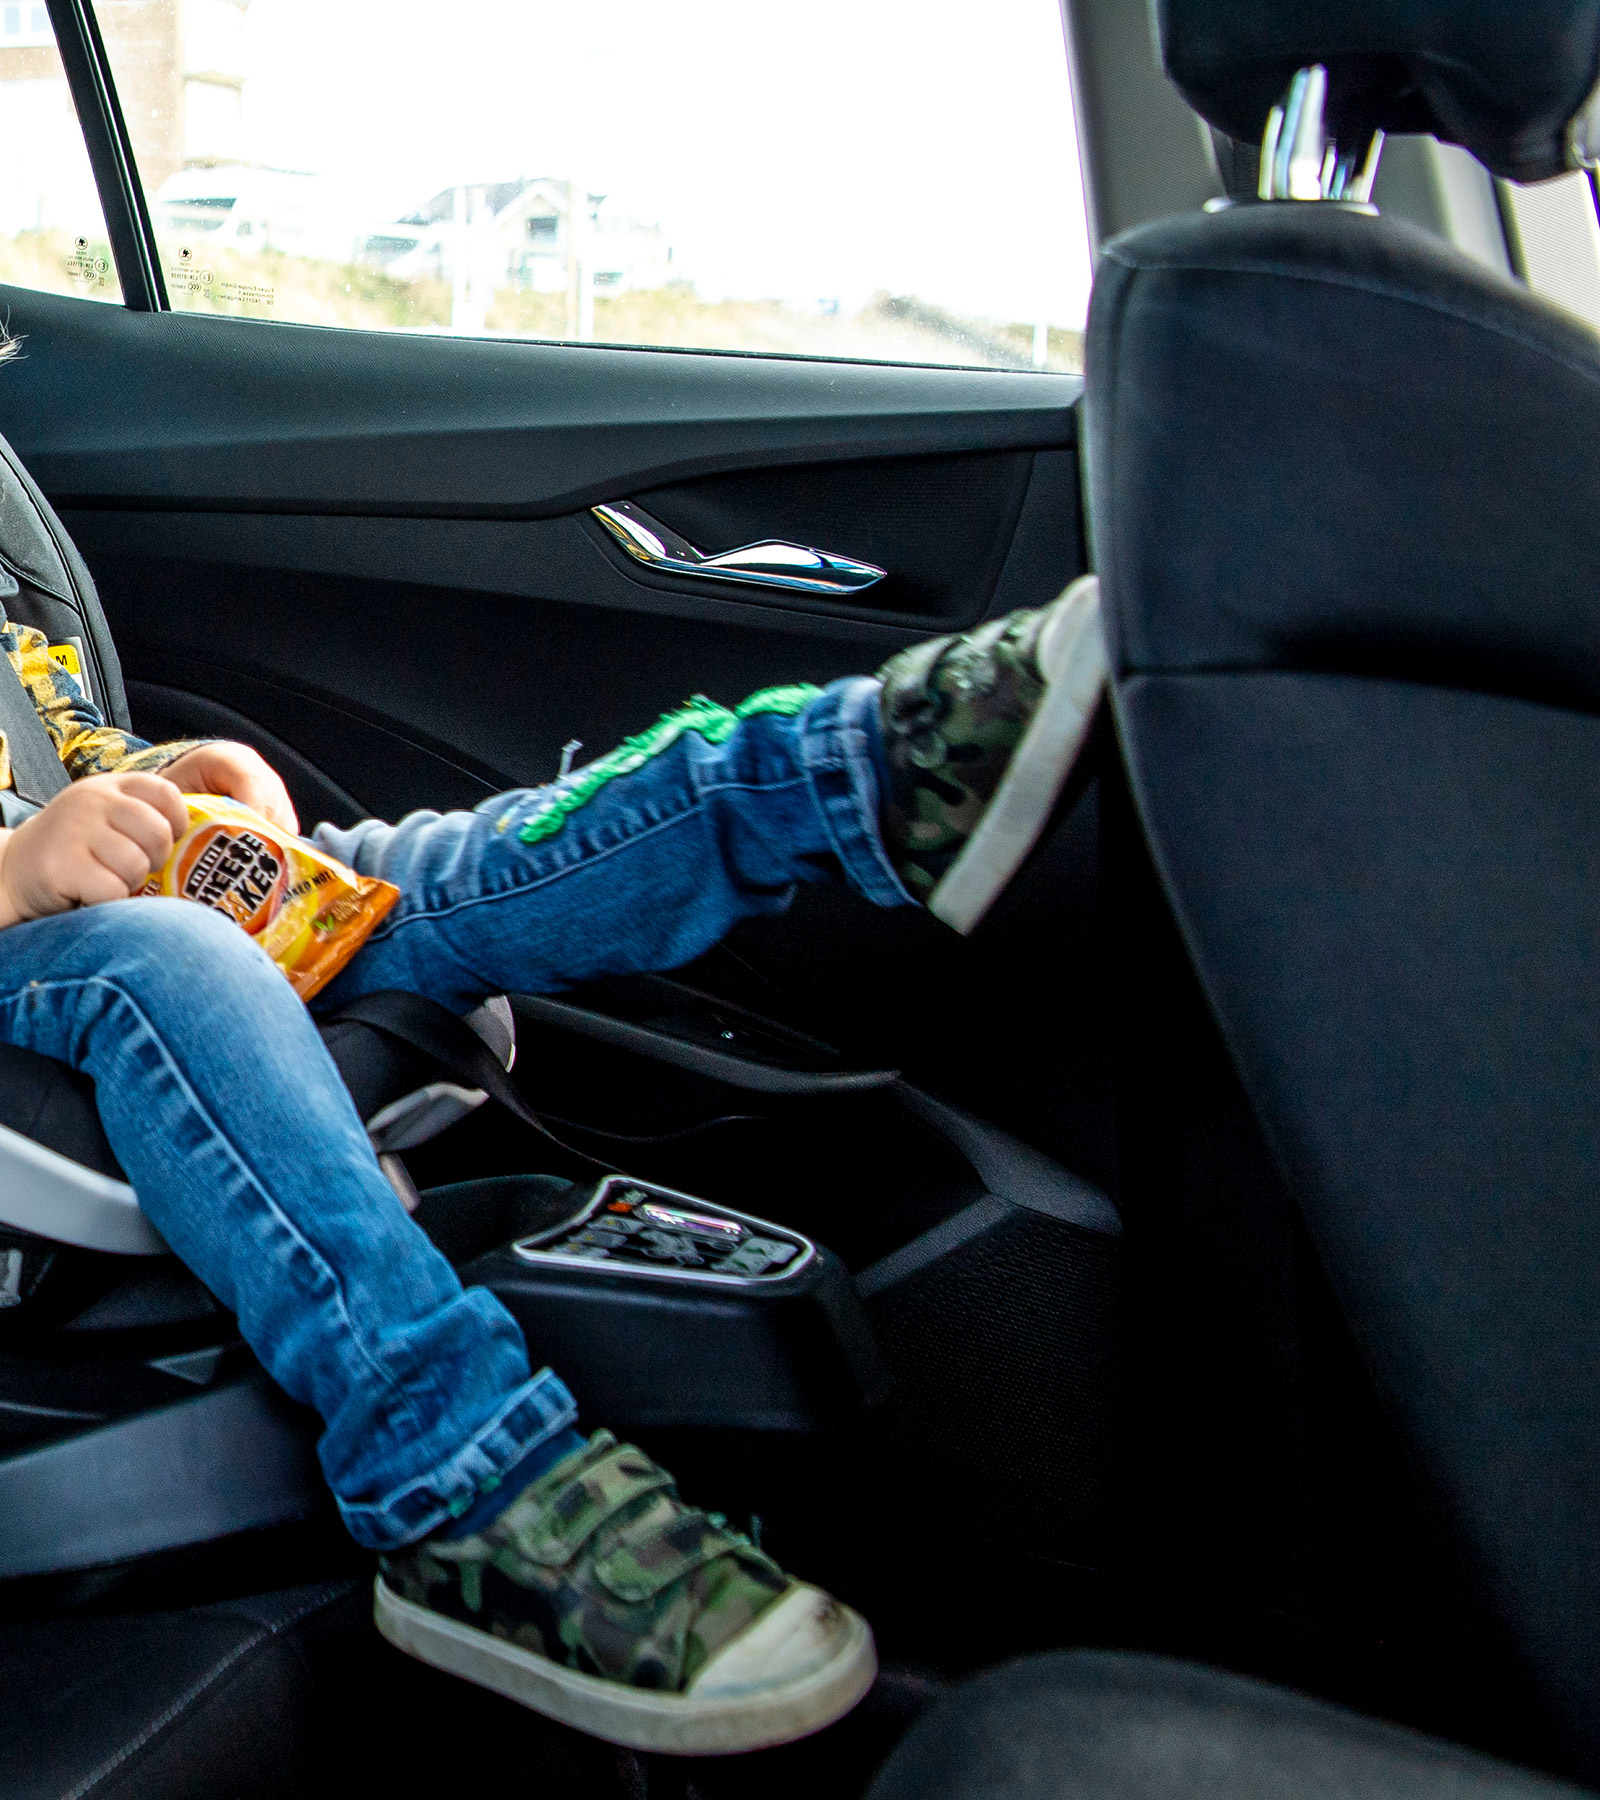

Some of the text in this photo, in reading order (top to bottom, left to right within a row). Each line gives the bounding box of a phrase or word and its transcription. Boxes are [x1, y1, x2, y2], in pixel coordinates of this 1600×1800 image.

[190, 844, 221, 887] mini
[197, 833, 266, 907] HEESE
[214, 853, 279, 921] AKES
